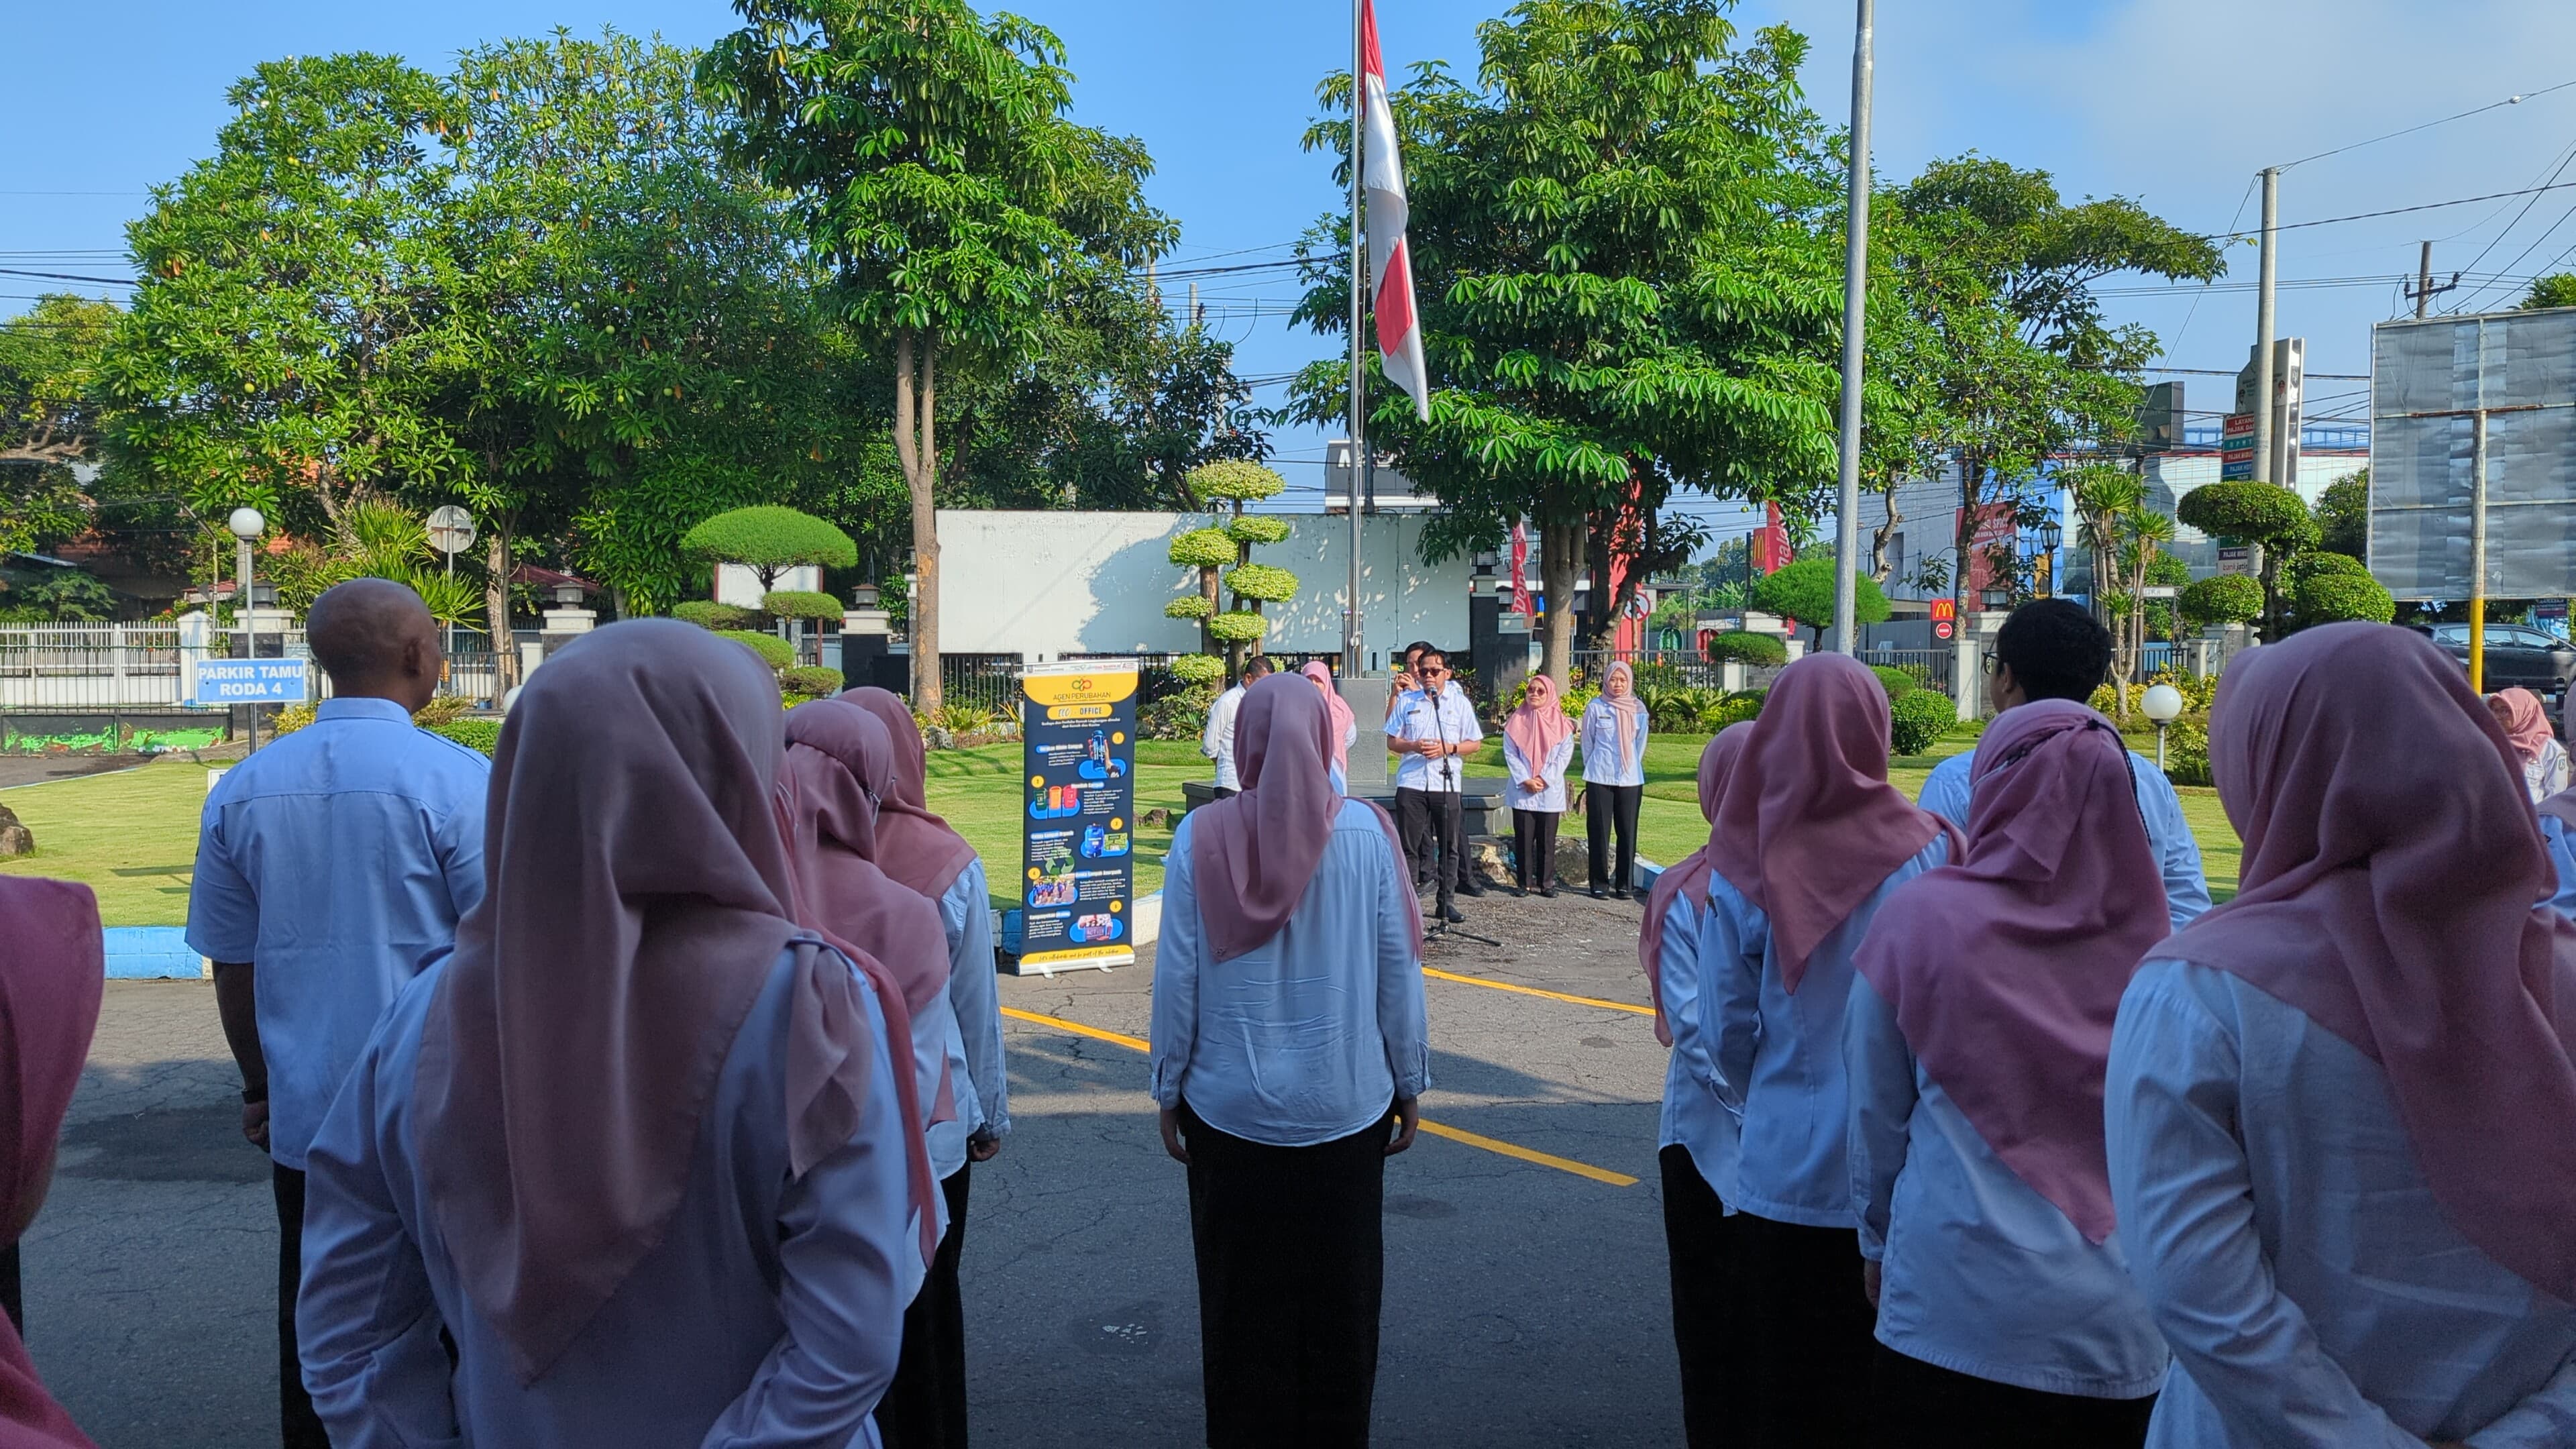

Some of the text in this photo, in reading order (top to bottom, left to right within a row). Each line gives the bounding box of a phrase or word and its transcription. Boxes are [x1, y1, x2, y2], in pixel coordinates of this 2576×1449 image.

[198, 665, 303, 680] PARKIR TAMU
[219, 682, 283, 696] RODA 4
[1071, 692, 1111, 700] PERUBAHAN
[1079, 707, 1102, 715] OFFICE
